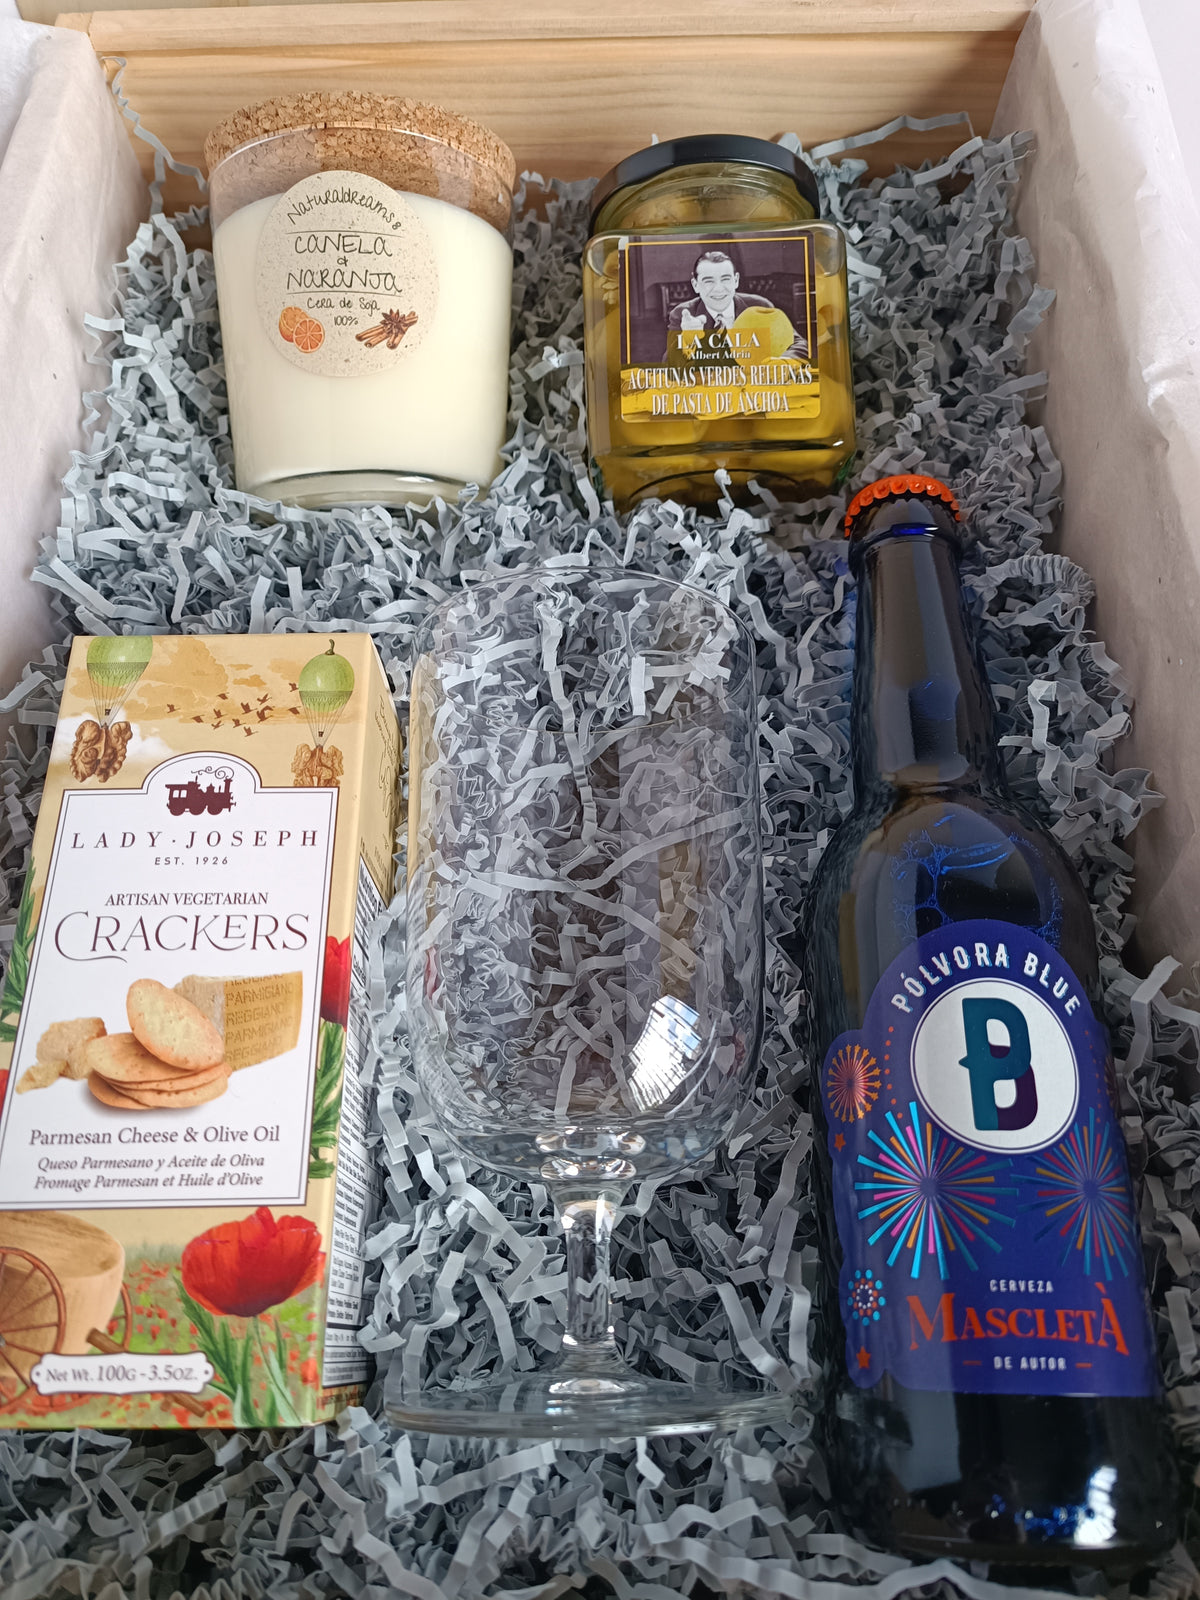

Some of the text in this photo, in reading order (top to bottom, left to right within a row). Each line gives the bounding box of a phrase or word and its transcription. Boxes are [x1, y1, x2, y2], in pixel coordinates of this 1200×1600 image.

[294, 233, 393, 257] CANELA
[286, 268, 403, 293] NARANJA
[339, 298, 352, 309] de
[358, 296, 381, 317] Soja
[333, 315, 359, 327] 100%
[676, 331, 761, 350] LA CALA
[689, 350, 720, 360] Albert
[627, 363, 813, 391] ACEITUNAS VERDES RELLENAS
[652, 391, 790, 416] DE PASTA DE ANCHOA
[154, 855, 229, 866] EST. 1926
[105, 891, 269, 907] ARTISAN VEGETARIAN
[54, 911, 310, 964] CRACKERS
[891, 942, 1081, 1017] PÓLVORA BLUE
[29, 1125, 280, 1146] Parmesan Cheese & Olive Oil
[38, 1153, 265, 1172] Queso Parmesano y Aceite de Oliva
[34, 1175, 91, 1193] Fromage
[93, 1175, 159, 1189] Parmesan
[162, 1175, 175, 1187] et
[177, 1173, 214, 1188] Huile
[990, 1279, 1054, 1293] CERVEZA
[994, 1356, 1067, 1371] DE AUTOR
[46, 1368, 68, 1382] Net
[72, 1367, 94, 1382] Wt.
